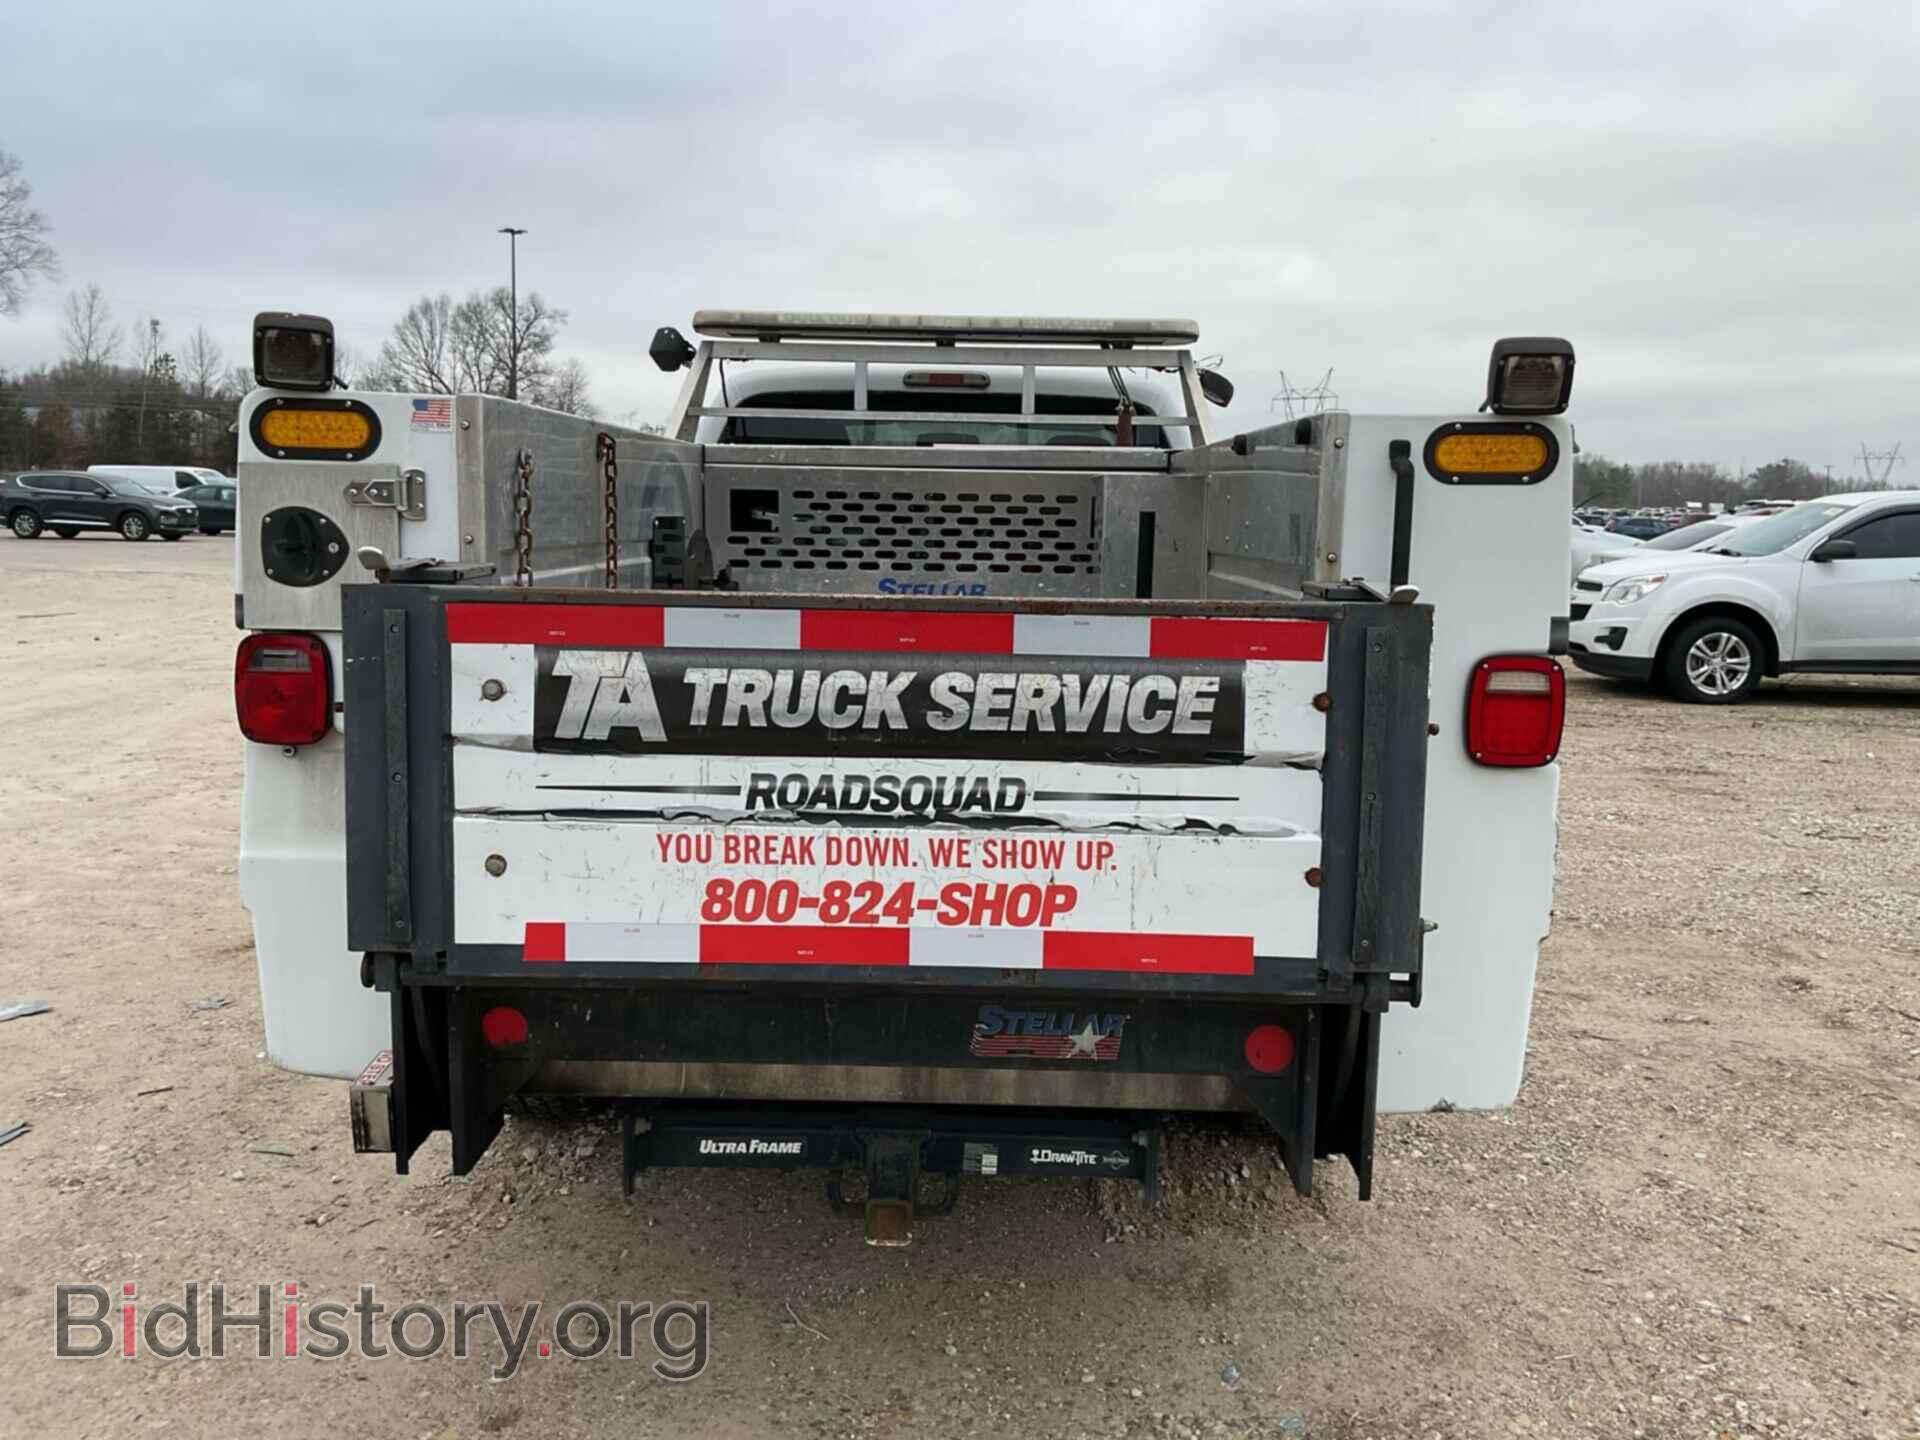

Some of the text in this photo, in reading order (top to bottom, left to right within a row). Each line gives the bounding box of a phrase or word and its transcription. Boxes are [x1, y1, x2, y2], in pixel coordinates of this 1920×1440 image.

[683, 667, 918, 731] TRUCK
[926, 671, 1220, 735] SERVICE
[745, 773, 1027, 813] ROADSQUAD
[656, 833, 1118, 872] YOU BREAK DOWN. WE SHOW UP.
[700, 878, 1078, 927] 800-824-SHOP
[976, 1004, 1124, 1036] STELLAR
[699, 1139, 803, 1154] ULTRA FRAME
